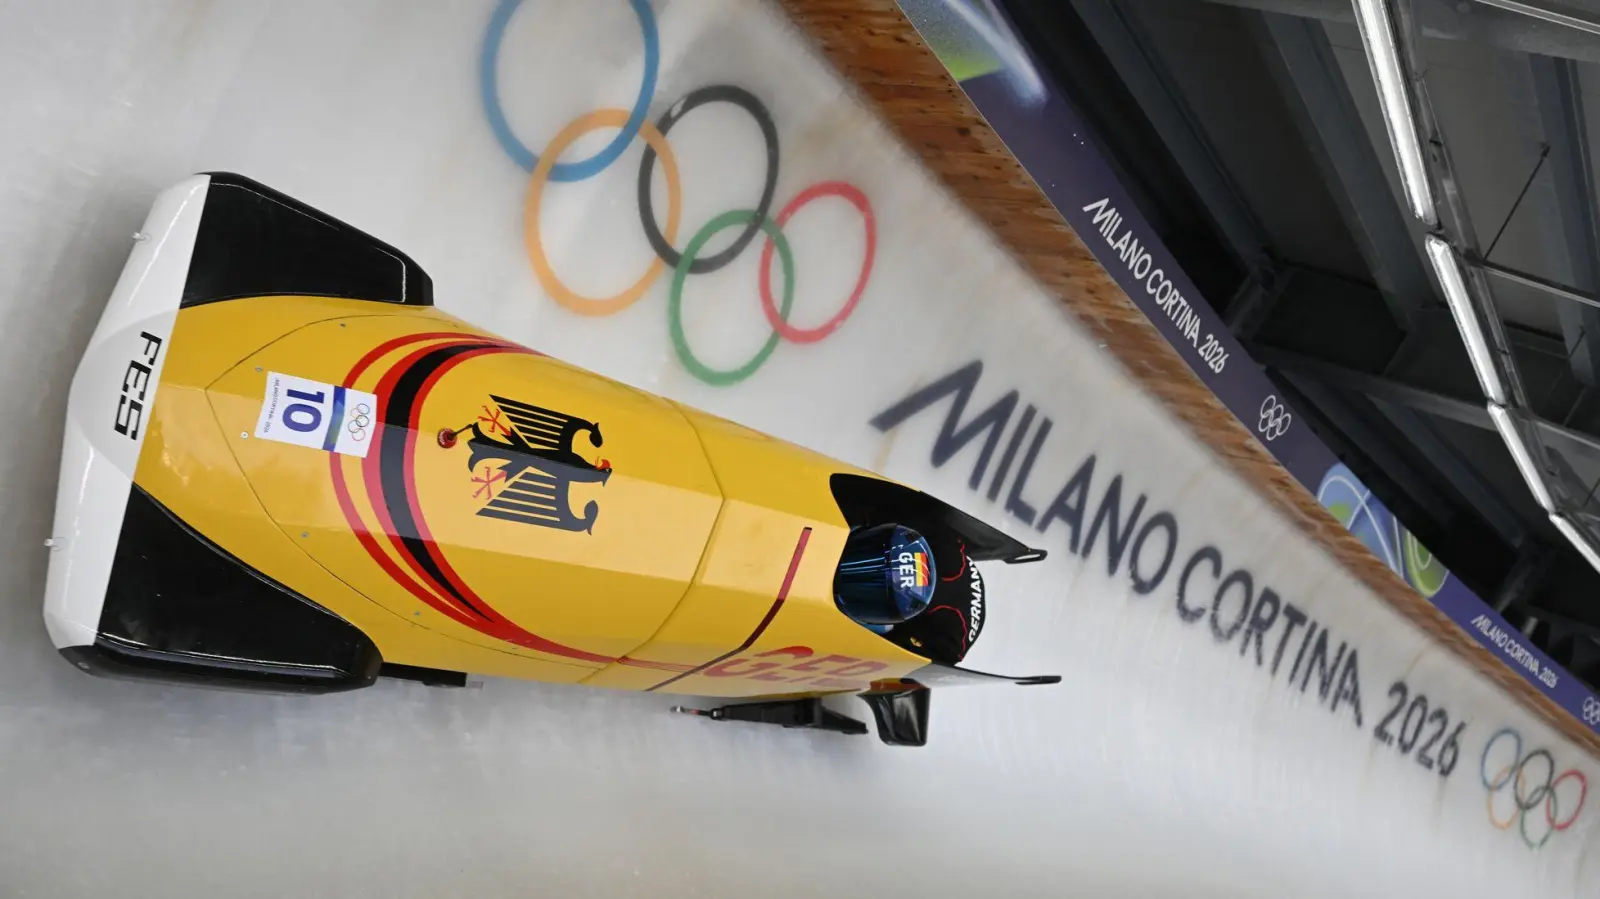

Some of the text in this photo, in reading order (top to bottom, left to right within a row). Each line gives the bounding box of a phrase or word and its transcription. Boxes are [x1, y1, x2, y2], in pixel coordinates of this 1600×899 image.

[1082, 198, 1230, 374] MILANO CORTINA 2026
[114, 331, 162, 441] FES
[282, 388, 325, 433] 10
[867, 359, 1467, 778] MILANO CORTINA 2026
[898, 552, 915, 588] GER
[966, 555, 983, 643] GERMANY
[1470, 614, 1559, 689] MILANO CORTINA 2026
